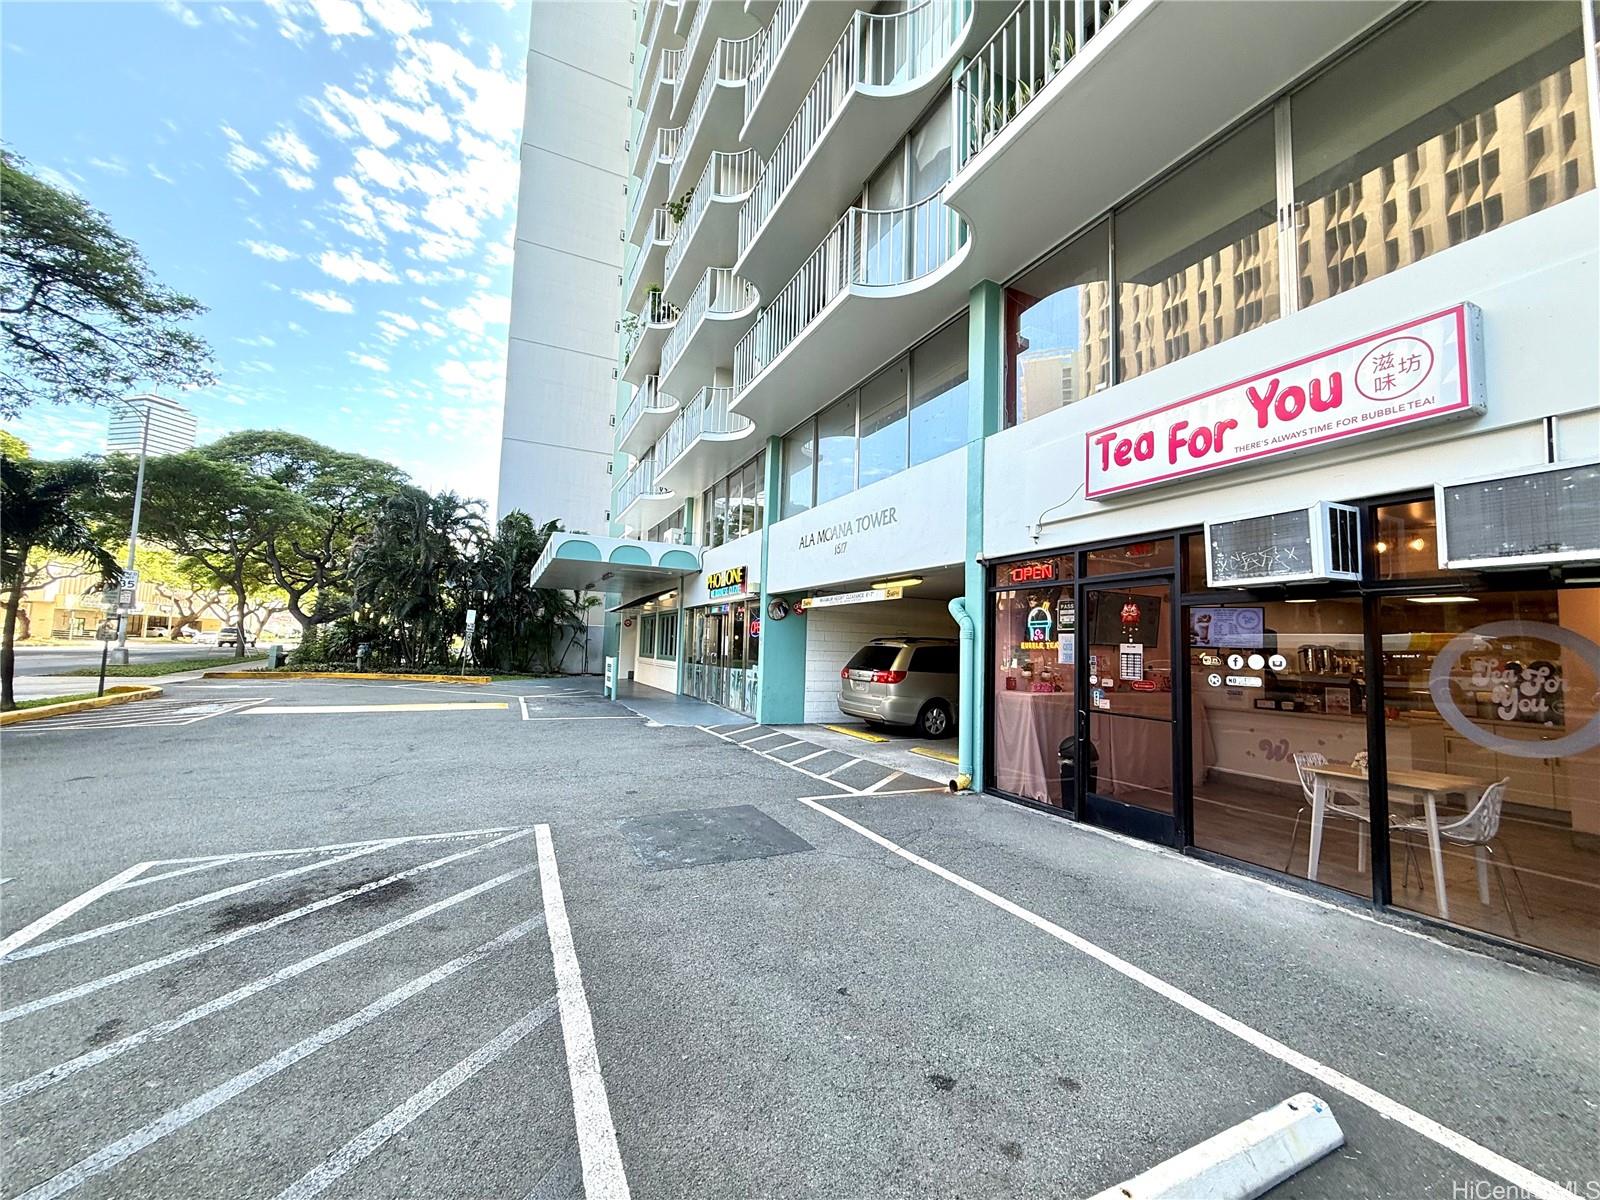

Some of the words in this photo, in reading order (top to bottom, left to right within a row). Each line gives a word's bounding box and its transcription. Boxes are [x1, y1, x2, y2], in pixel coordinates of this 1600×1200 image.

[1095, 430, 1155, 472] Tea
[1168, 418, 1238, 465] For
[1245, 371, 1343, 429] You
[1234, 439, 1270, 453] THERE'S
[1271, 429, 1308, 445] ALWAYS
[1308, 423, 1333, 435] TIME
[1336, 418, 1359, 429] FOR
[1361, 404, 1406, 422] BUBBLE
[1407, 395, 1437, 411] TEA!
[799, 533, 815, 550] ALA
[817, 521, 853, 545] MOANA
[855, 506, 898, 533] TOWER
[834, 541, 848, 555] 1517
[120, 579, 135, 588] 35
[1012, 564, 1053, 581] OPEN
[1491, 684, 1549, 721] You
